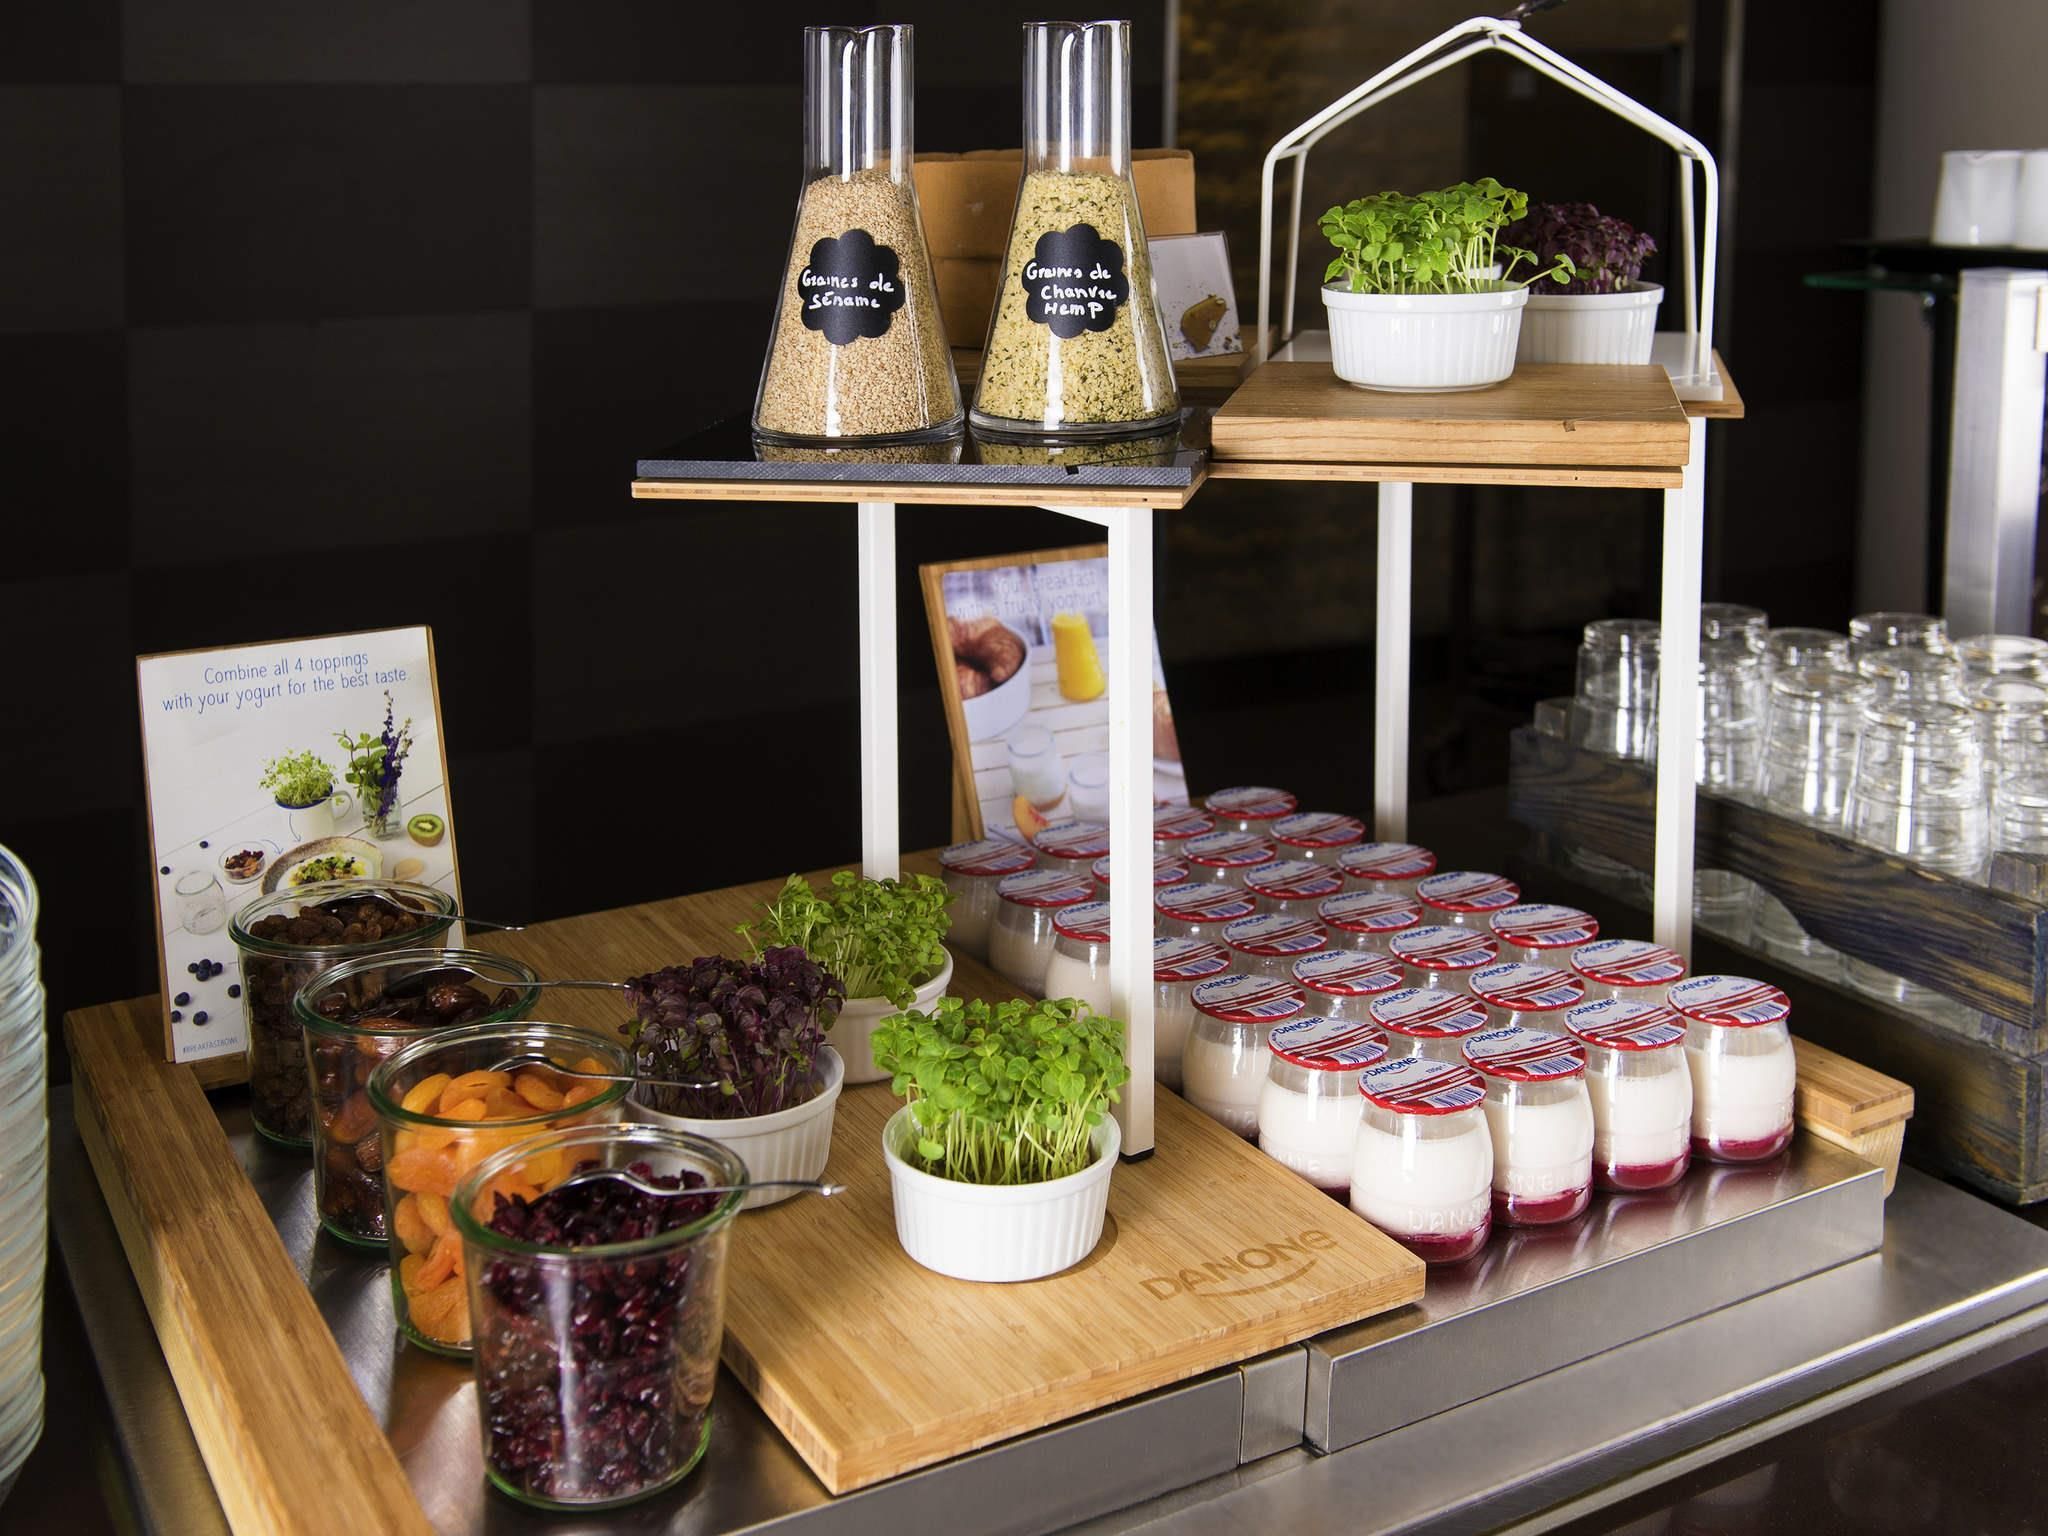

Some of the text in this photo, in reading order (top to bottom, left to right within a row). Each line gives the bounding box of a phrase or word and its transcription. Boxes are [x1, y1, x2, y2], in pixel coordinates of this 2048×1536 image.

[802, 269, 894, 292] Graines de
[1089, 262, 1111, 280] de
[1032, 568, 1096, 591] breakfast
[1048, 590, 1101, 613] yoghurt
[204, 653, 369, 684] Combine all 4 toppings
[162, 668, 407, 714] with your yogurt for the best taste
[1199, 974, 1250, 990] DANONE
[1375, 988, 1420, 1006] DANONE
[1569, 998, 1617, 1016] DANONE
[1275, 1016, 1324, 1034] DANONE
[1471, 1026, 1525, 1043] DANONE
[1366, 1057, 1419, 1077] DANONE
[1139, 1230, 1338, 1301] DANONE
